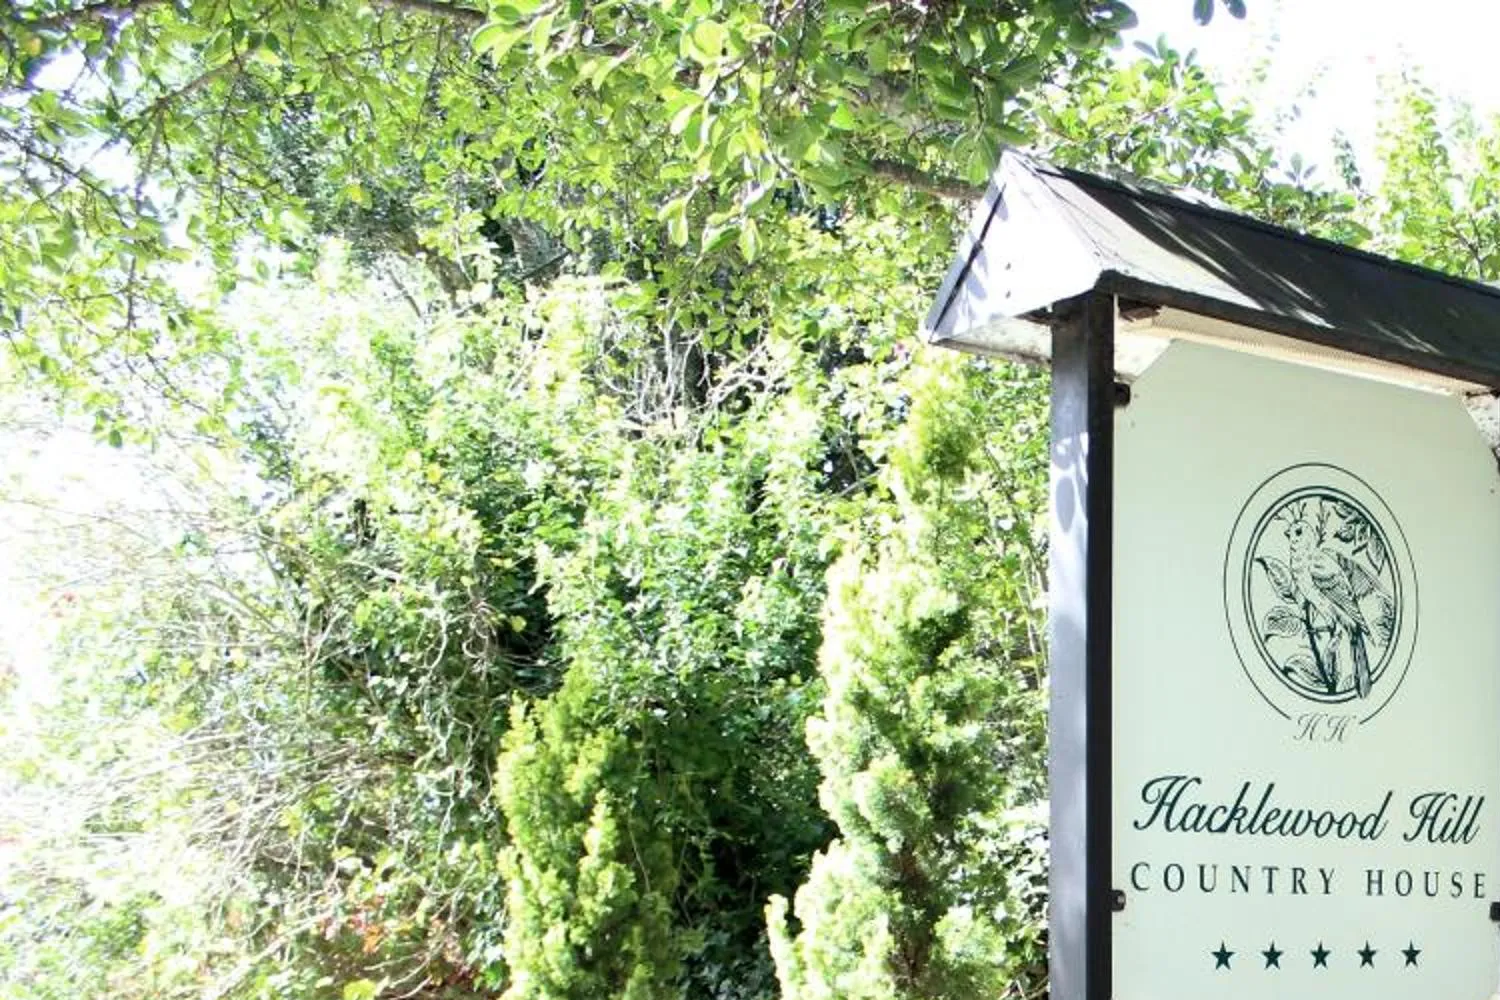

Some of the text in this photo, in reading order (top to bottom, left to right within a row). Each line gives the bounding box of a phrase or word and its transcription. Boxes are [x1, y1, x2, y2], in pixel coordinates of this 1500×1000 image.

[1133, 775, 1486, 845] Hacklewood Hill
[1130, 862, 1487, 900] COUNTRY HOUSE
